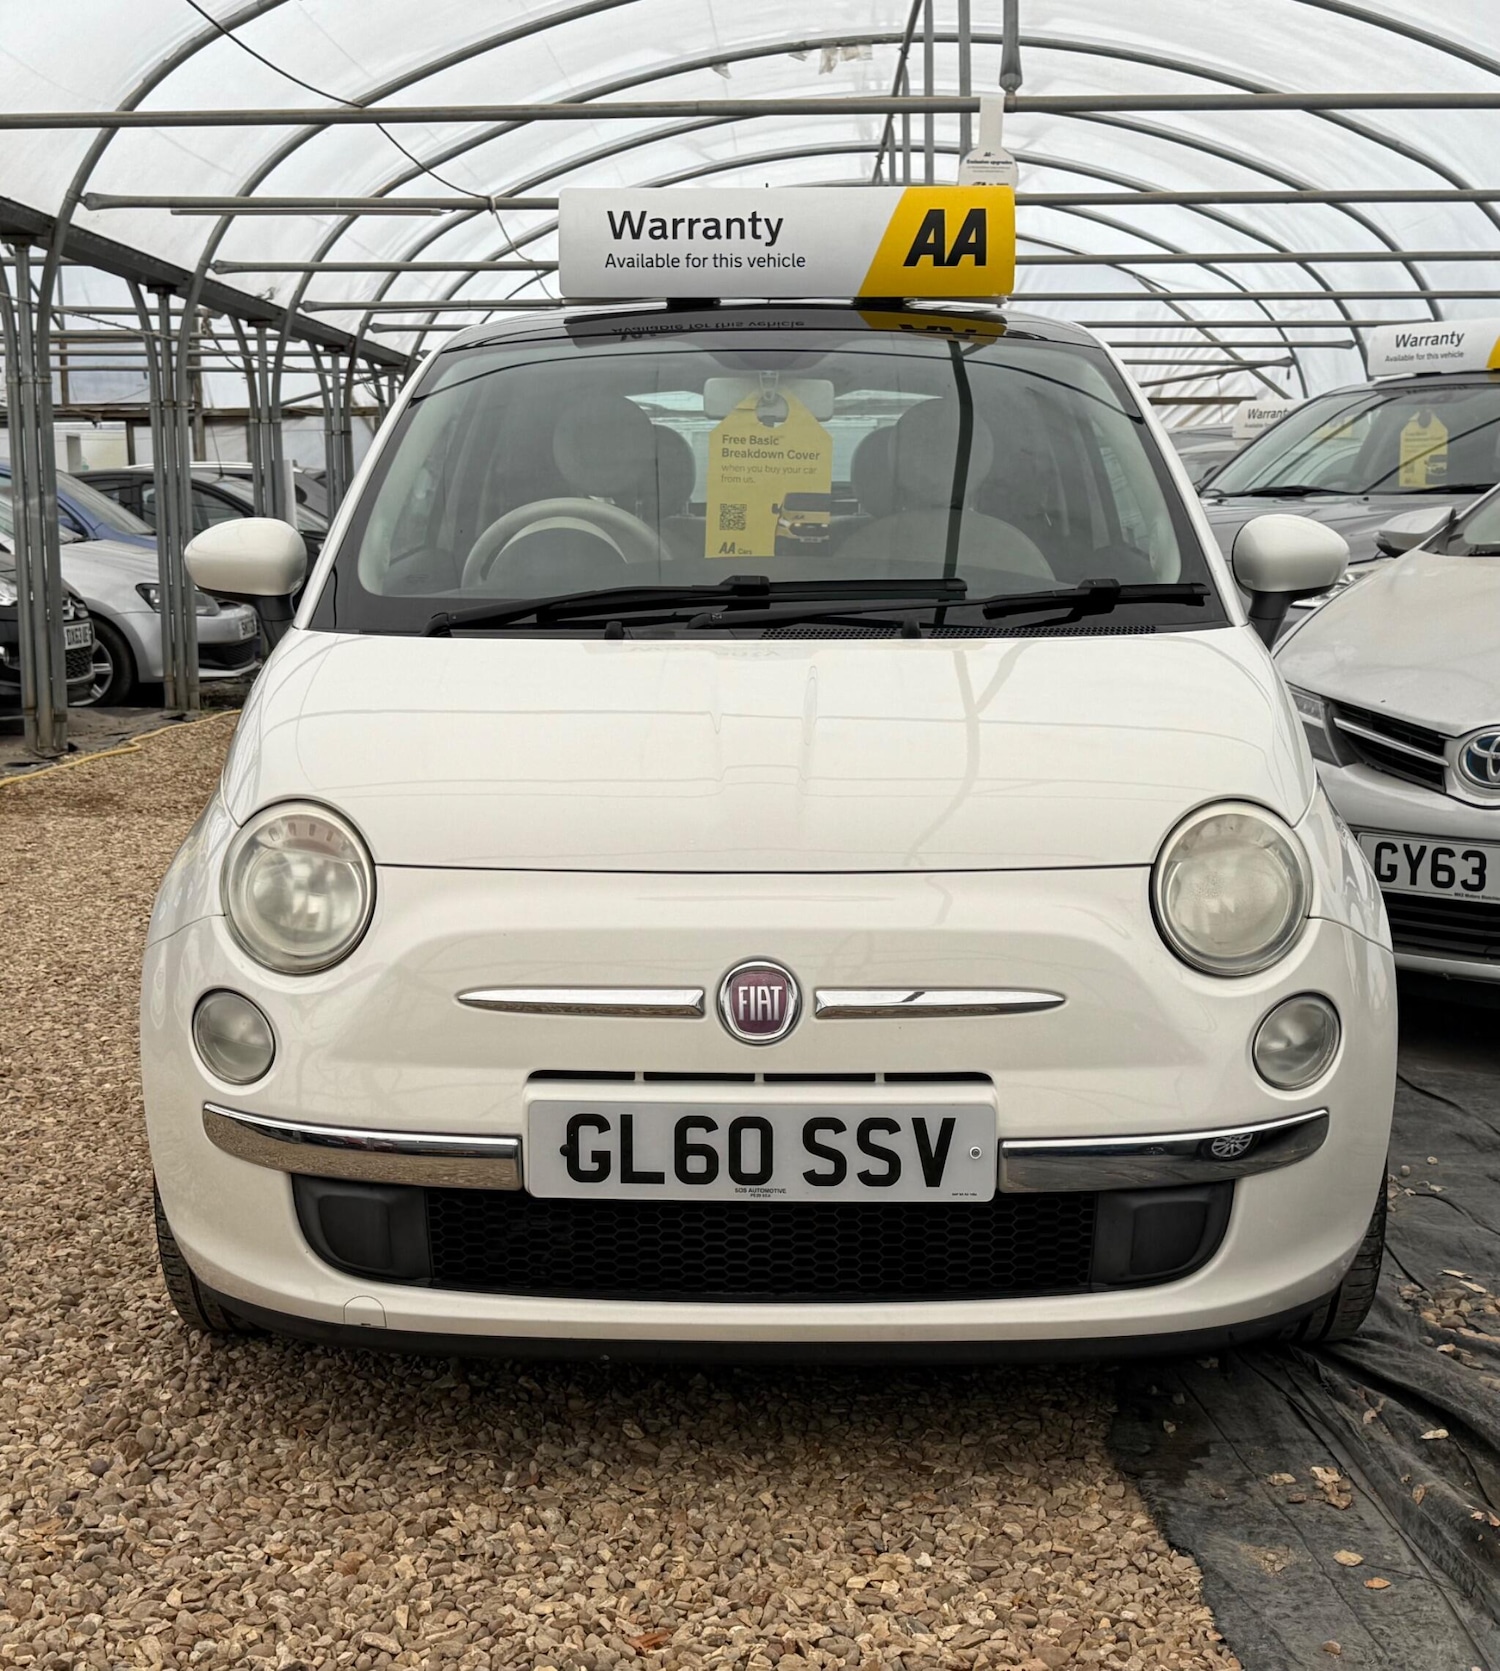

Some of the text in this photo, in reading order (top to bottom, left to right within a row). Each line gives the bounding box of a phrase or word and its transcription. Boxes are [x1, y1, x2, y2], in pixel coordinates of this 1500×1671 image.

[606, 210, 784, 247] Warranty
[902, 208, 987, 267] AA
[604, 252, 806, 269] Available for this vehicle
[1395, 330, 1465, 349] Warranty
[1384, 350, 1465, 363] Available for this vehicle
[1247, 407, 1289, 420] Warrant
[721, 434, 780, 446] Free Basic
[721, 447, 821, 461] Breakdown Cover
[720, 464, 818, 476] when you buy your car
[720, 474, 756, 485] from us.
[718, 541, 753, 556] AA Cars
[1374, 841, 1487, 892] GY63
[738, 985, 783, 1021] FIAT
[566, 1113, 957, 1188] GL60 SSV
[748, 1187, 787, 1195] AUTOMOTIVE
